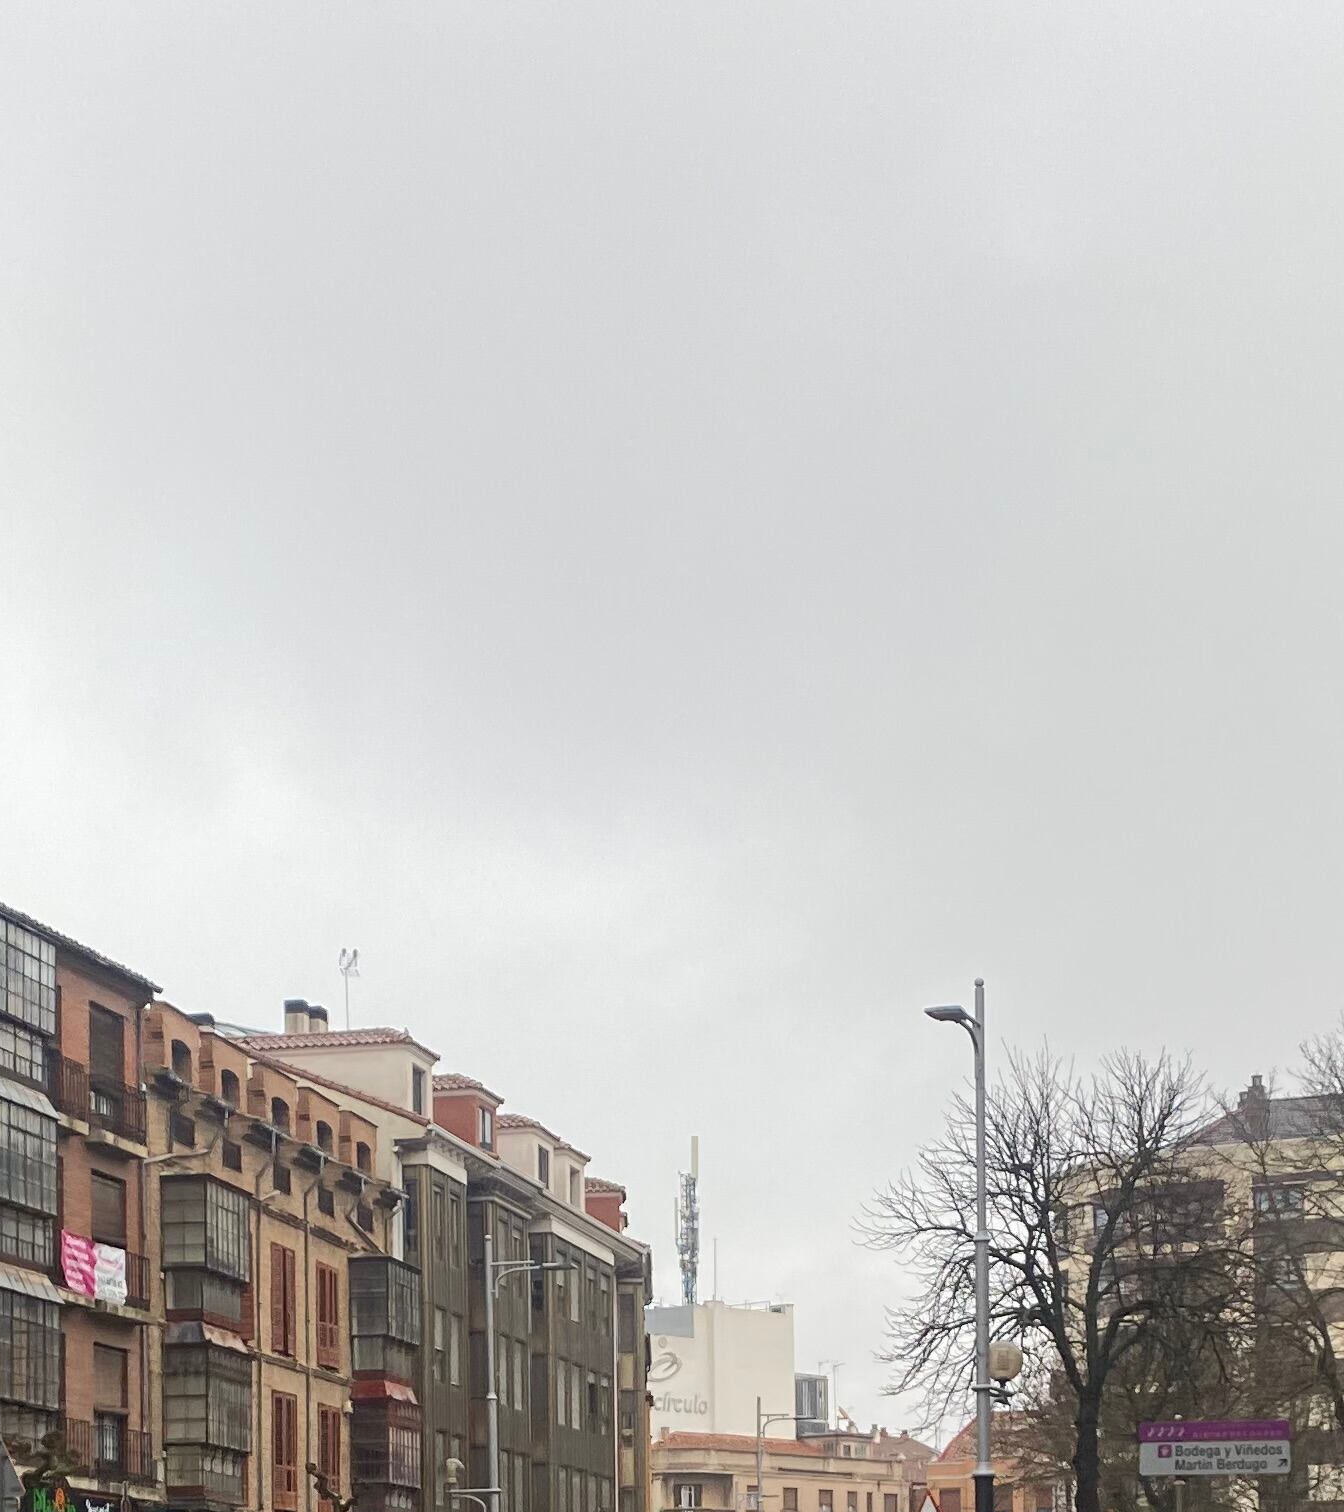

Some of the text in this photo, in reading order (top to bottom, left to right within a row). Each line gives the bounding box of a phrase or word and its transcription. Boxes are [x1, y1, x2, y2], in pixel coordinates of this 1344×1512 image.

[1174, 1444, 1221, 1459] Bodega
[1234, 1443, 1283, 1456] Viñedos
[1216, 1458, 1268, 1472] Berdugo
